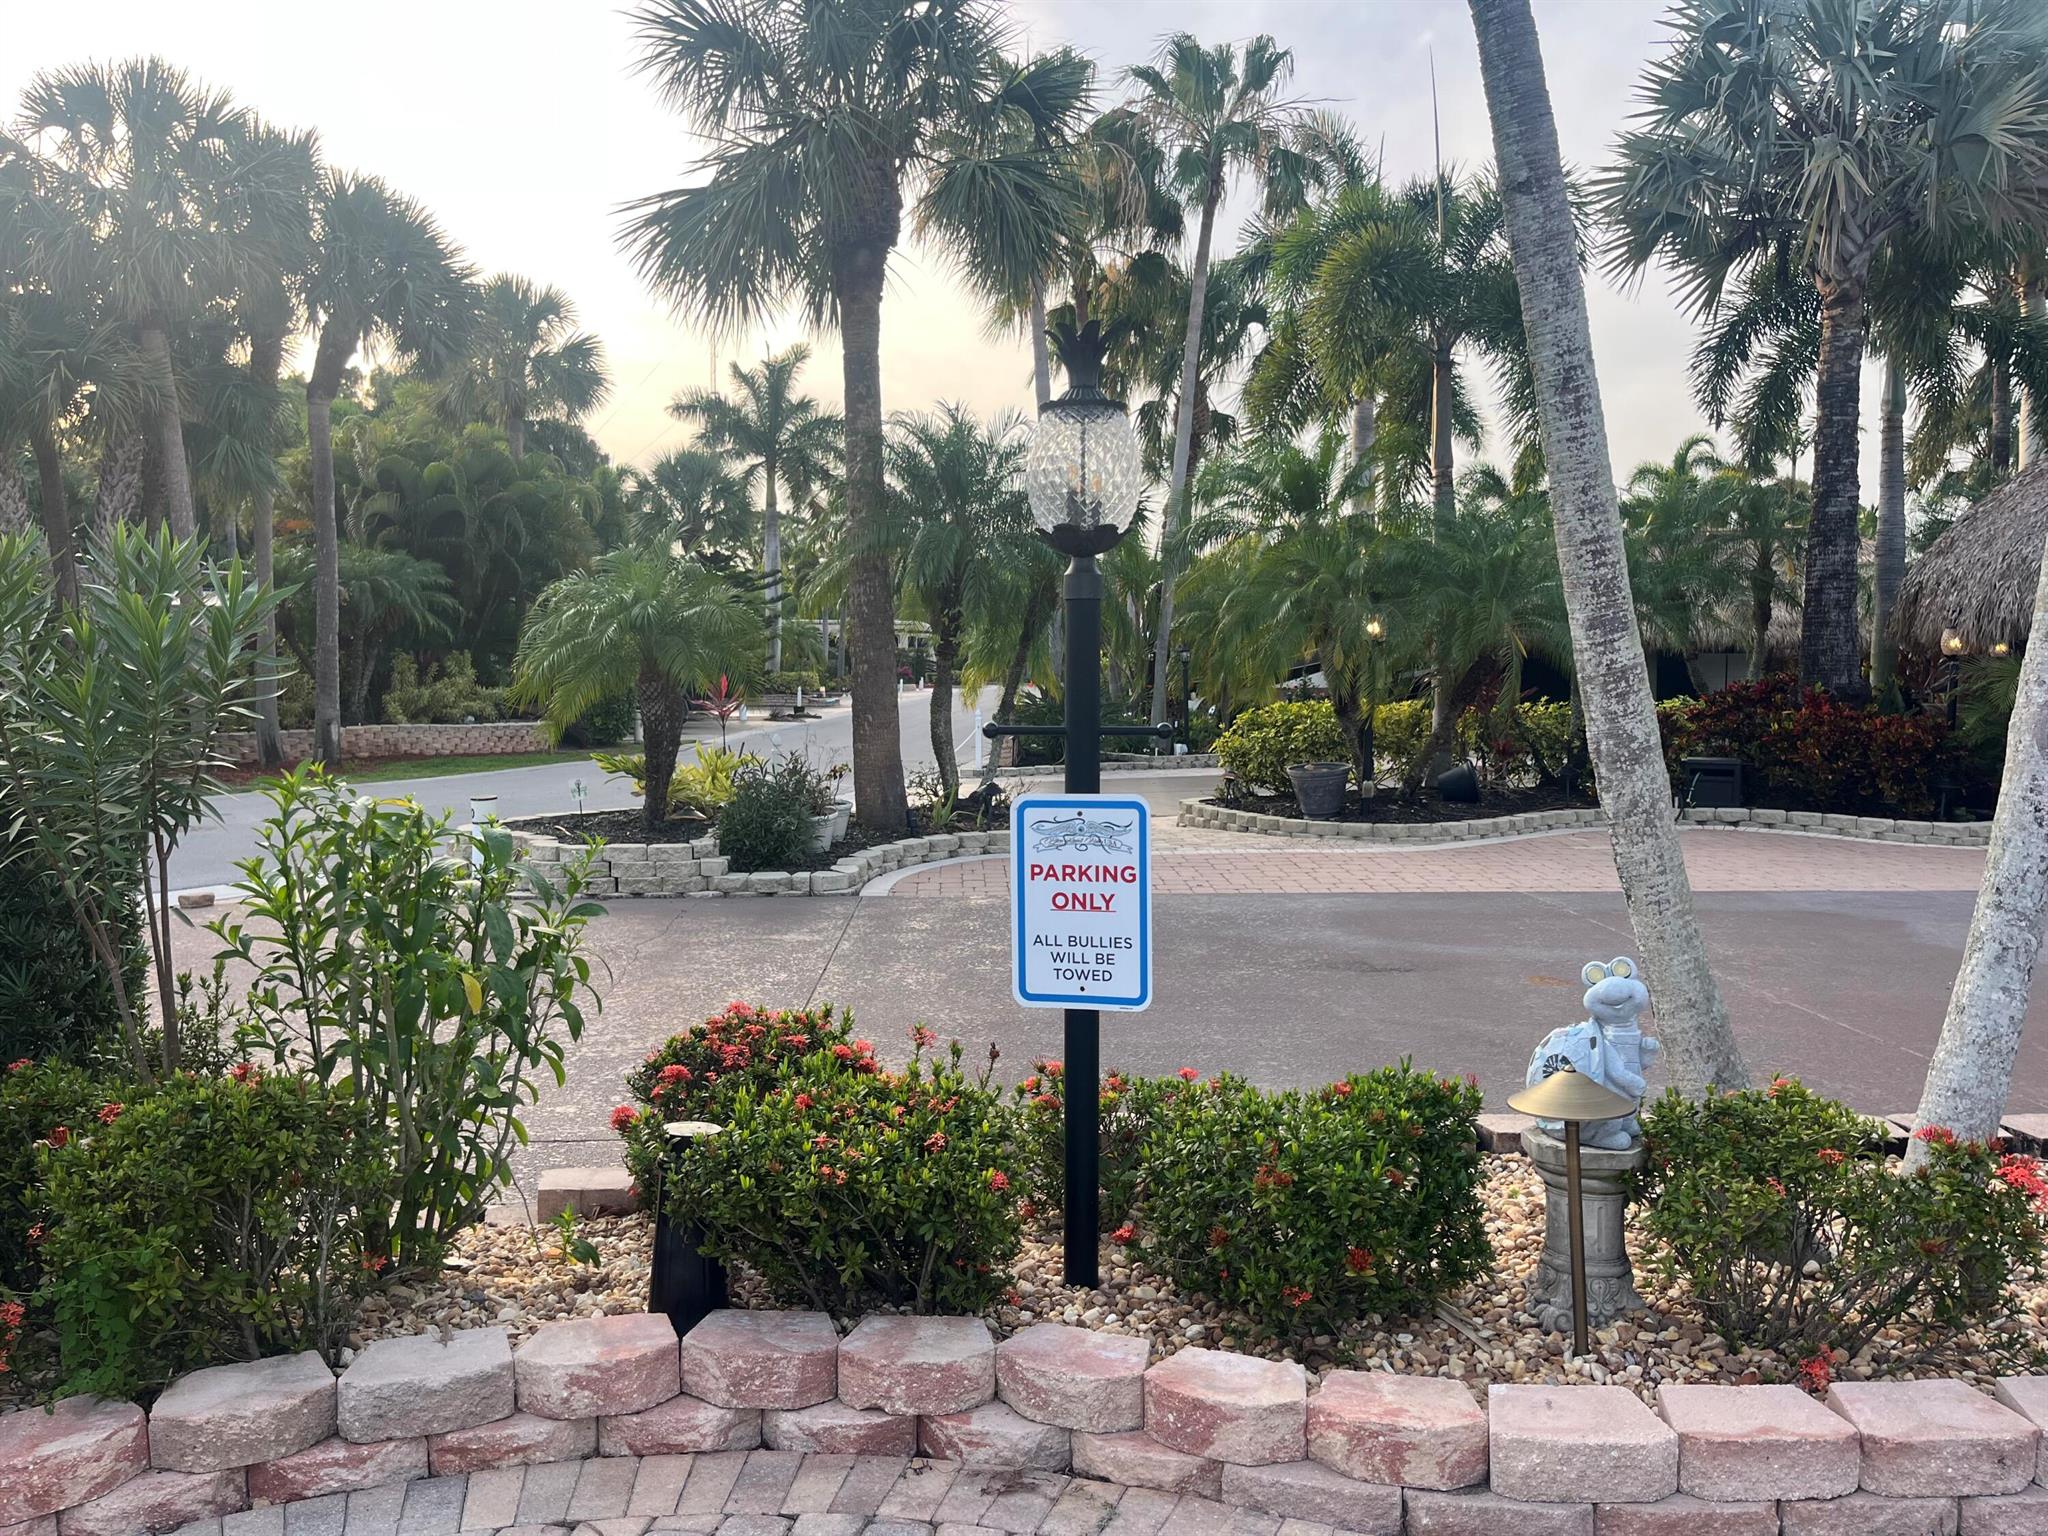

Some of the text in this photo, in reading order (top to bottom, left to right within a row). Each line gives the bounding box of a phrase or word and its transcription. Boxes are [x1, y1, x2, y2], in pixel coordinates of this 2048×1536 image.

[1030, 864, 1137, 883] PARKING
[1051, 892, 1115, 910] ONLY
[1033, 934, 1133, 949] ALL BULLIES
[1051, 952, 1116, 966] WILL BE
[1053, 968, 1113, 982] TOWED
